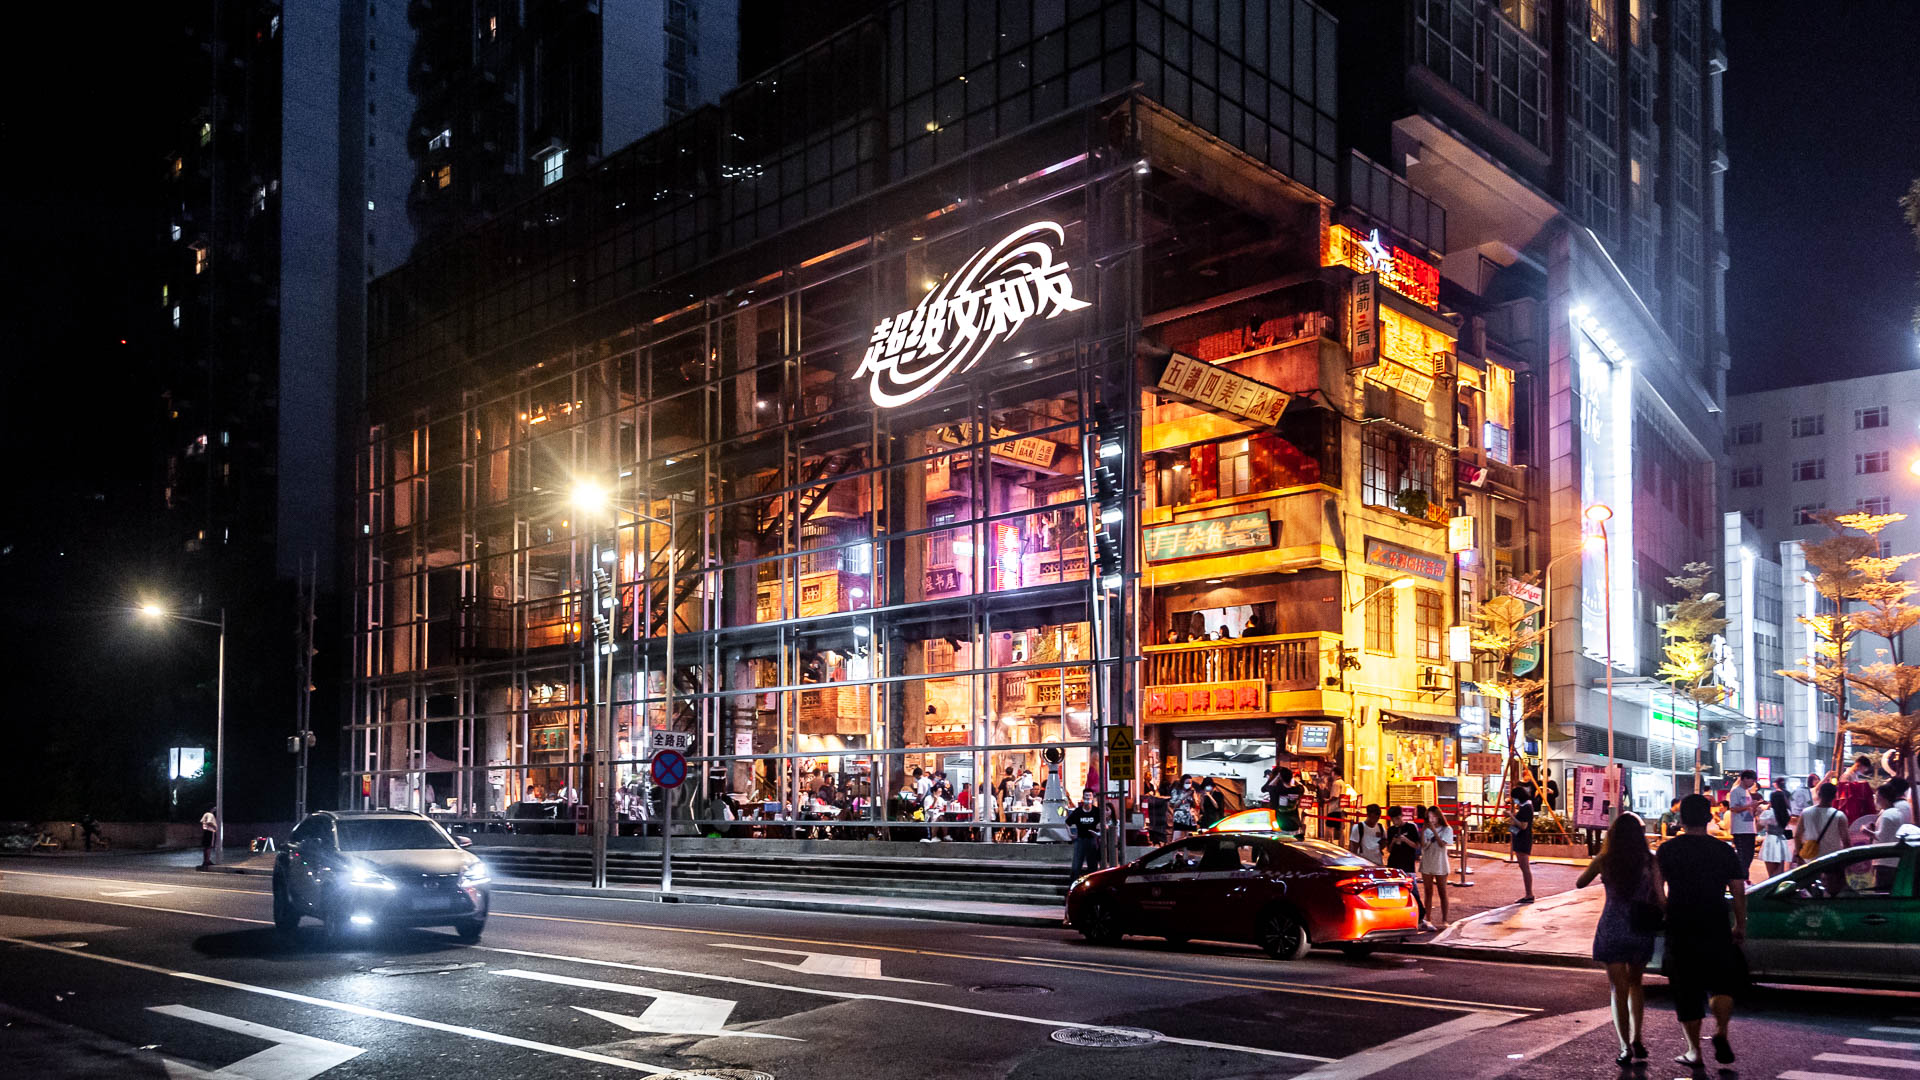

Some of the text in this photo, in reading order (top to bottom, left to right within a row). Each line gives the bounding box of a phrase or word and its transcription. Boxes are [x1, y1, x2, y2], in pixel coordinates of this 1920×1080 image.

[851, 228, 1093, 402] 超级文和友
[1355, 350, 1370, 362] BAR
[1019, 447, 1034, 459] BAR
[1149, 521, 1227, 557] 丁丁杂货
[654, 733, 687, 748] 全路段
